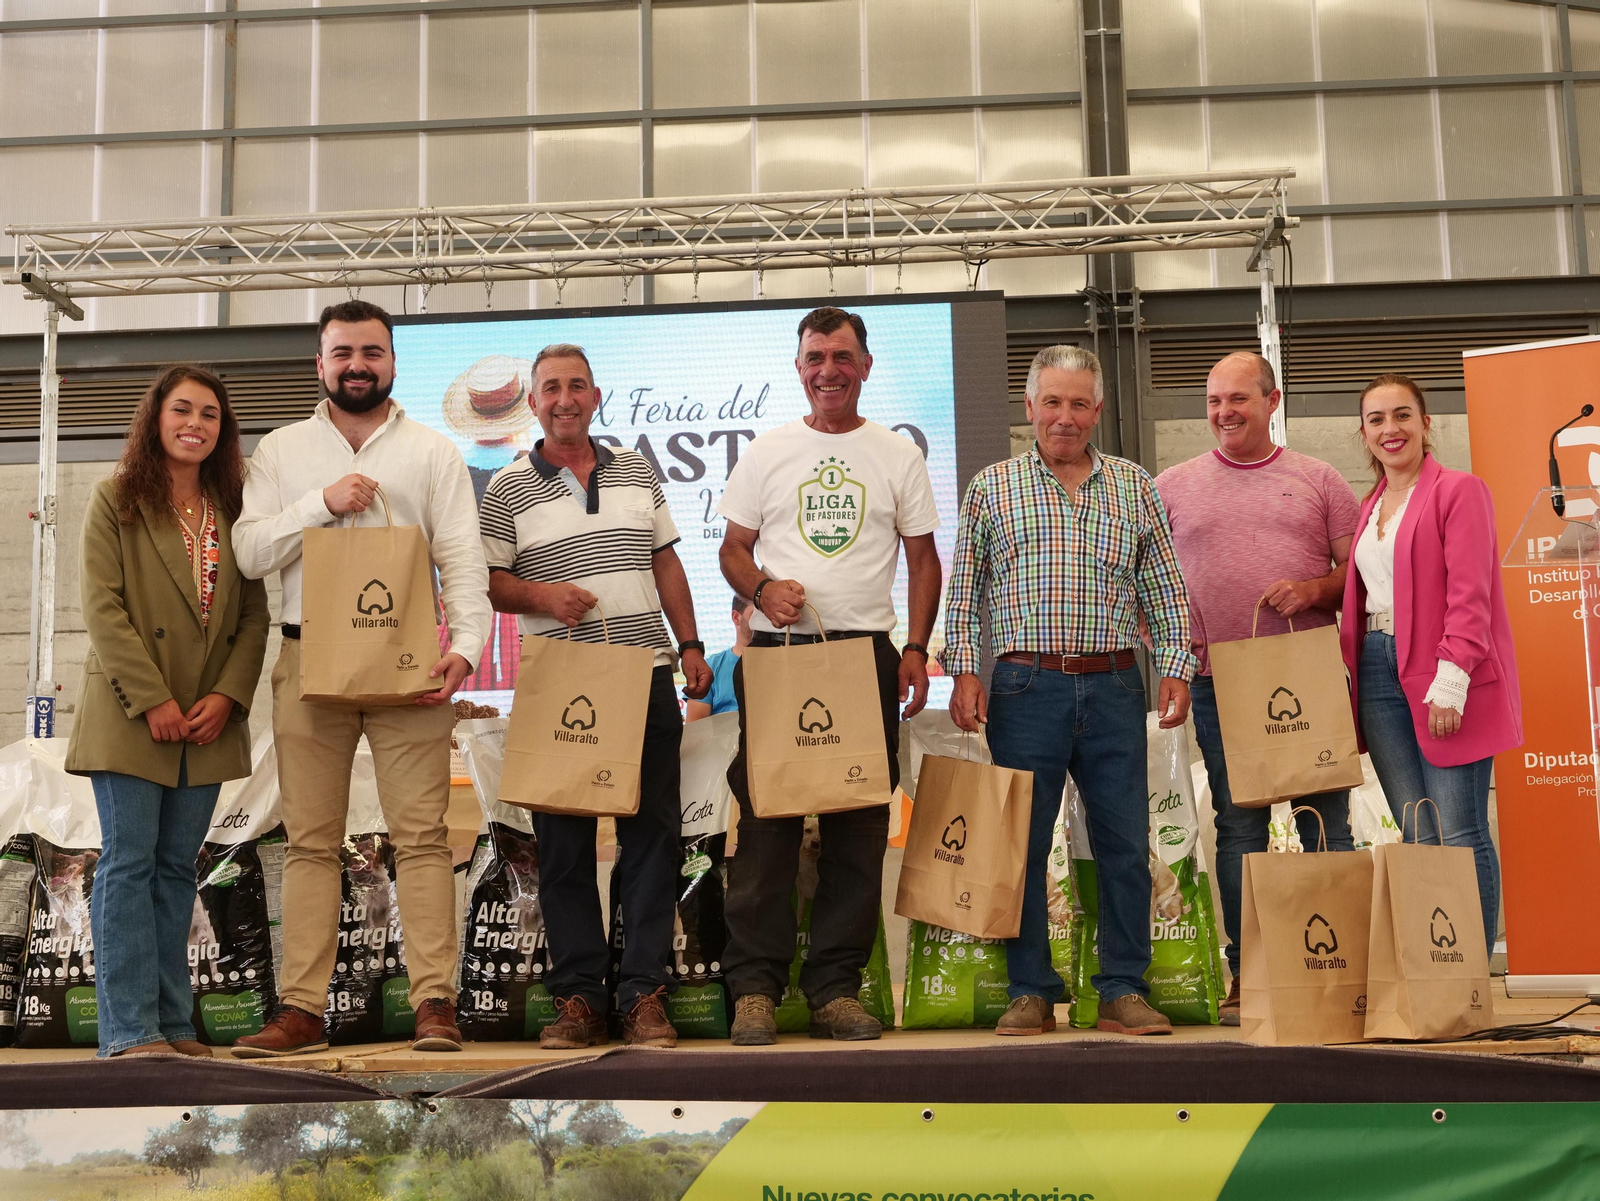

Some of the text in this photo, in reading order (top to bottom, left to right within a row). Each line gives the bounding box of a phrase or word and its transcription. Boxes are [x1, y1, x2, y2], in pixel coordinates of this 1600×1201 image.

[629, 386, 710, 427] Feria
[717, 382, 771, 420] del
[828, 471, 836, 485] 1
[806, 494, 857, 511] LIGA
[806, 511, 857, 522] DE PASTORES
[351, 616, 399, 629] Villaralto
[1264, 720, 1310, 735] Villaralto
[554, 730, 599, 745] Villaralto
[795, 733, 841, 747] Villaralto
[1526, 773, 1593, 786] Delegación
[212, 807, 250, 828] ota
[681, 799, 714, 824] Cota
[934, 848, 965, 866] Villaralto
[31, 908, 58, 931] Alta
[476, 901, 521, 925] Alta
[1150, 922, 1198, 942] Diario
[473, 925, 549, 955] Energí
[1304, 956, 1347, 970] Villaralto
[1429, 950, 1464, 963] Villaralto
[921, 975, 957, 996] 18 Kg
[328, 991, 366, 1012] 18 Kg
[472, 990, 508, 1011] 18 Kg
[700, 992, 721, 1002] Animal
[24, 995, 51, 1016] 18 Kg
[203, 1001, 235, 1012] Alimentación
[674, 1004, 712, 1016] COVAP
[214, 1010, 248, 1023] COVAP
[238, 1023, 252, 1031] futuro
